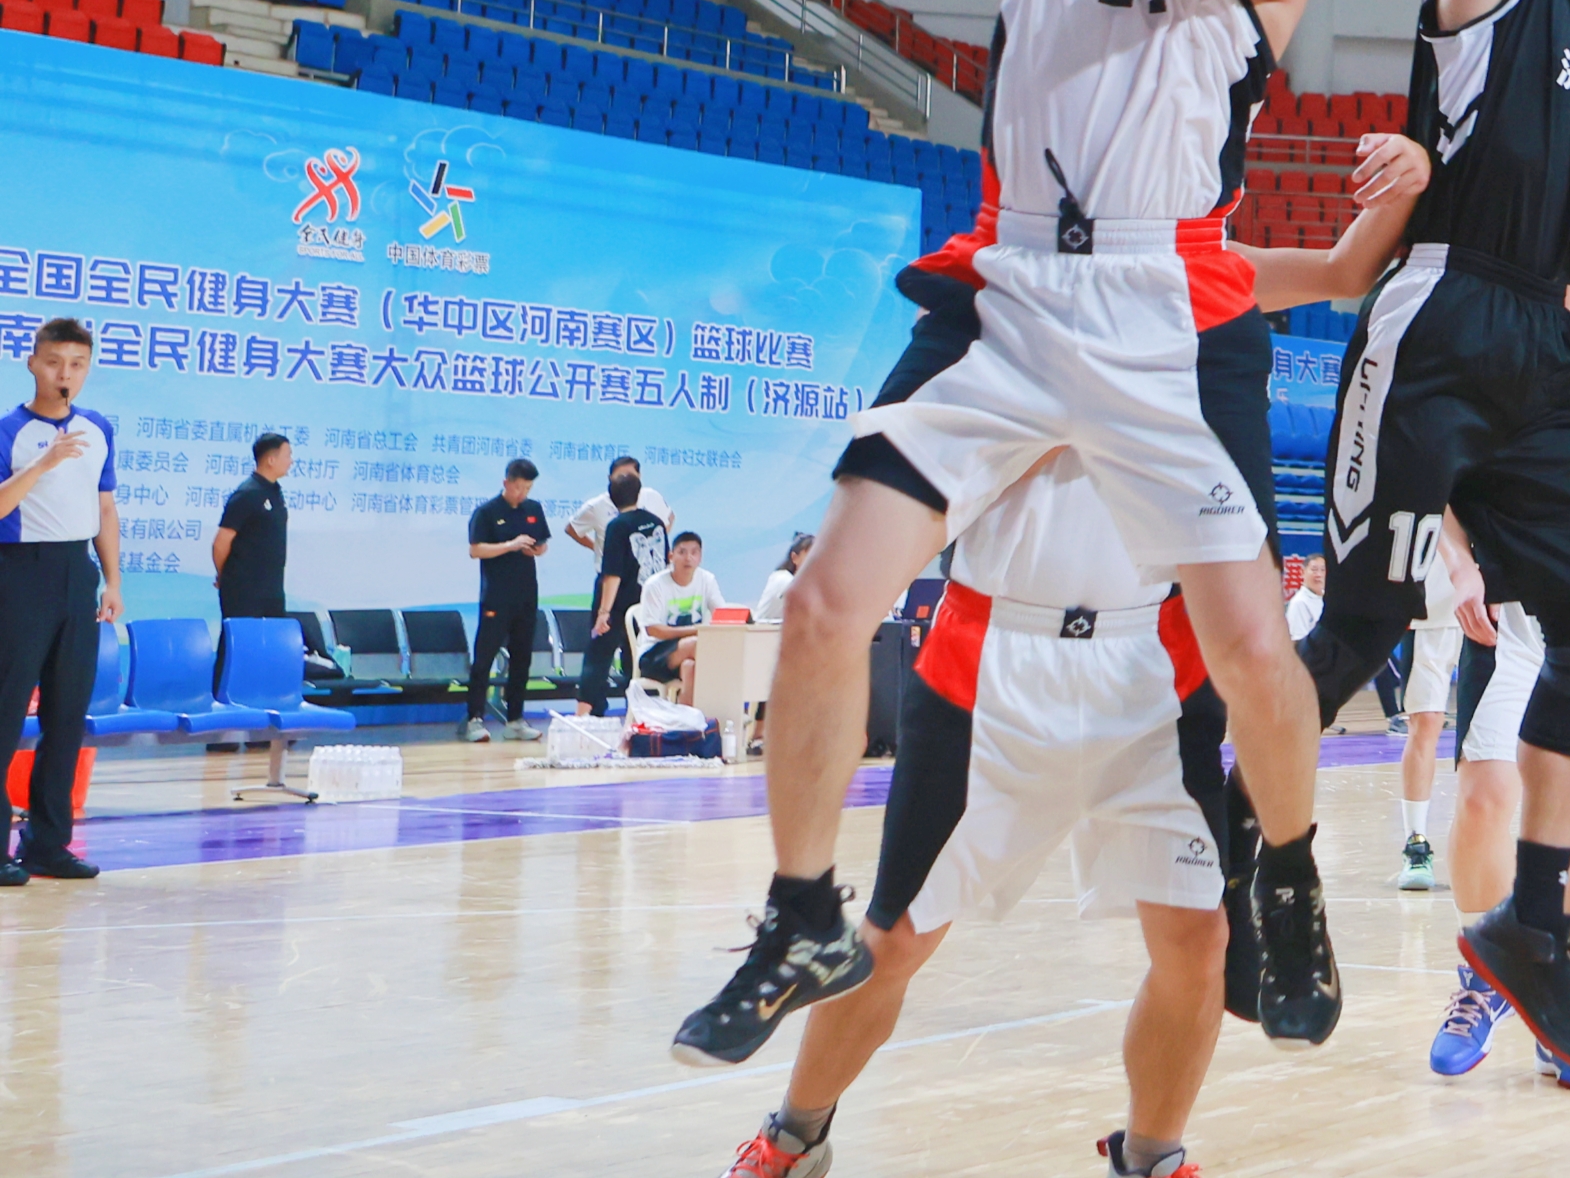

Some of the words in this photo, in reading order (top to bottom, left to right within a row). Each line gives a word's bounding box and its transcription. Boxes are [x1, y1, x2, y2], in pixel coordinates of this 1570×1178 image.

[386, 241, 491, 274] 中国体育彩票
[325, 427, 419, 453] 河南省总工会
[352, 460, 461, 485] 河南省体育总会
[1388, 510, 1443, 583] 10
